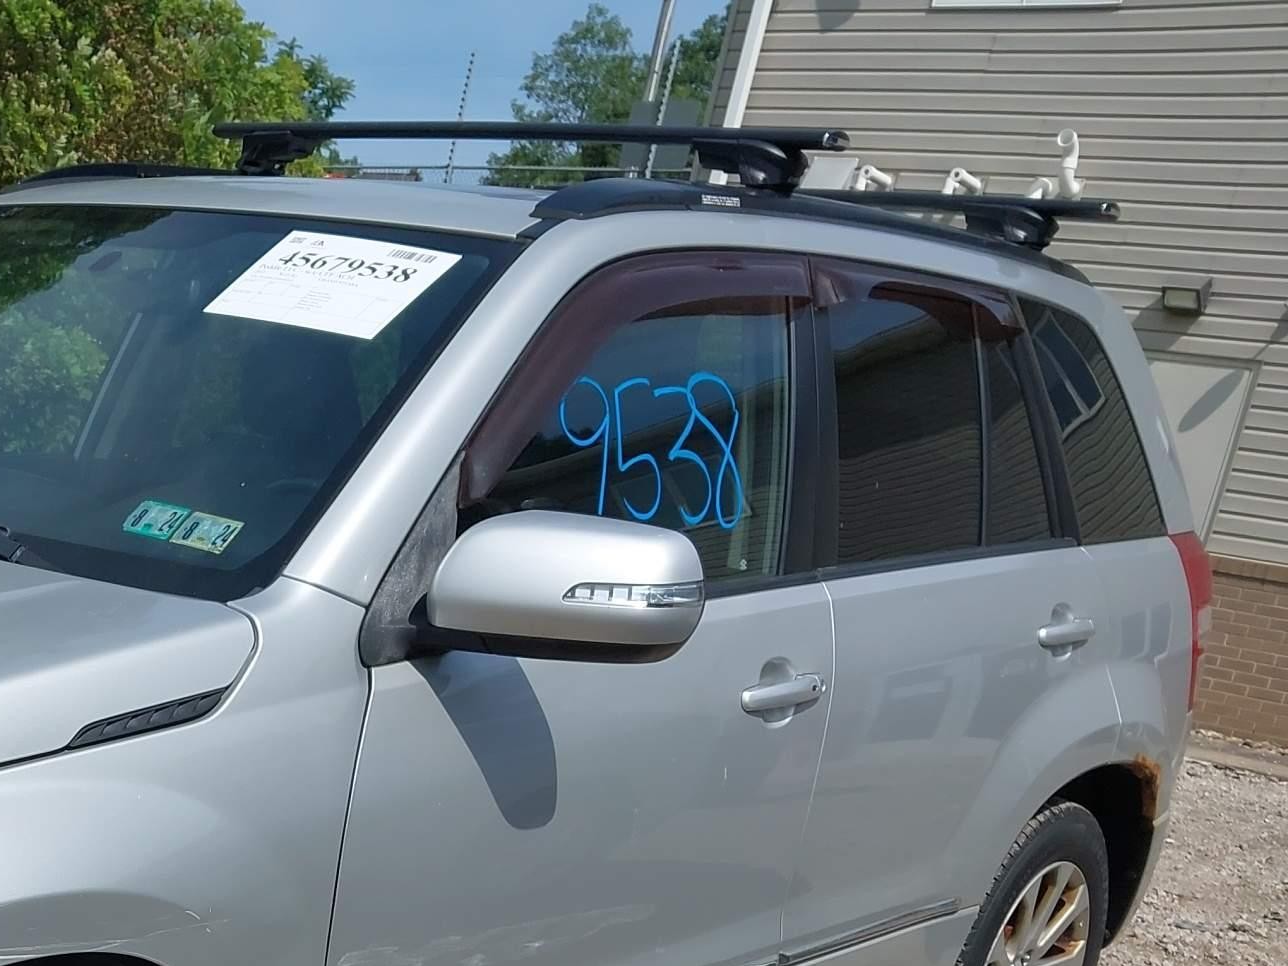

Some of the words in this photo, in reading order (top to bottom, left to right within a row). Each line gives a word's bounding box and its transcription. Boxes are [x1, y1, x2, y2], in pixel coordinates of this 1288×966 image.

[278, 251, 418, 284] 45679538
[560, 371, 743, 528] 9538
[158, 511, 183, 533] 24
[212, 524, 238, 547] 24
